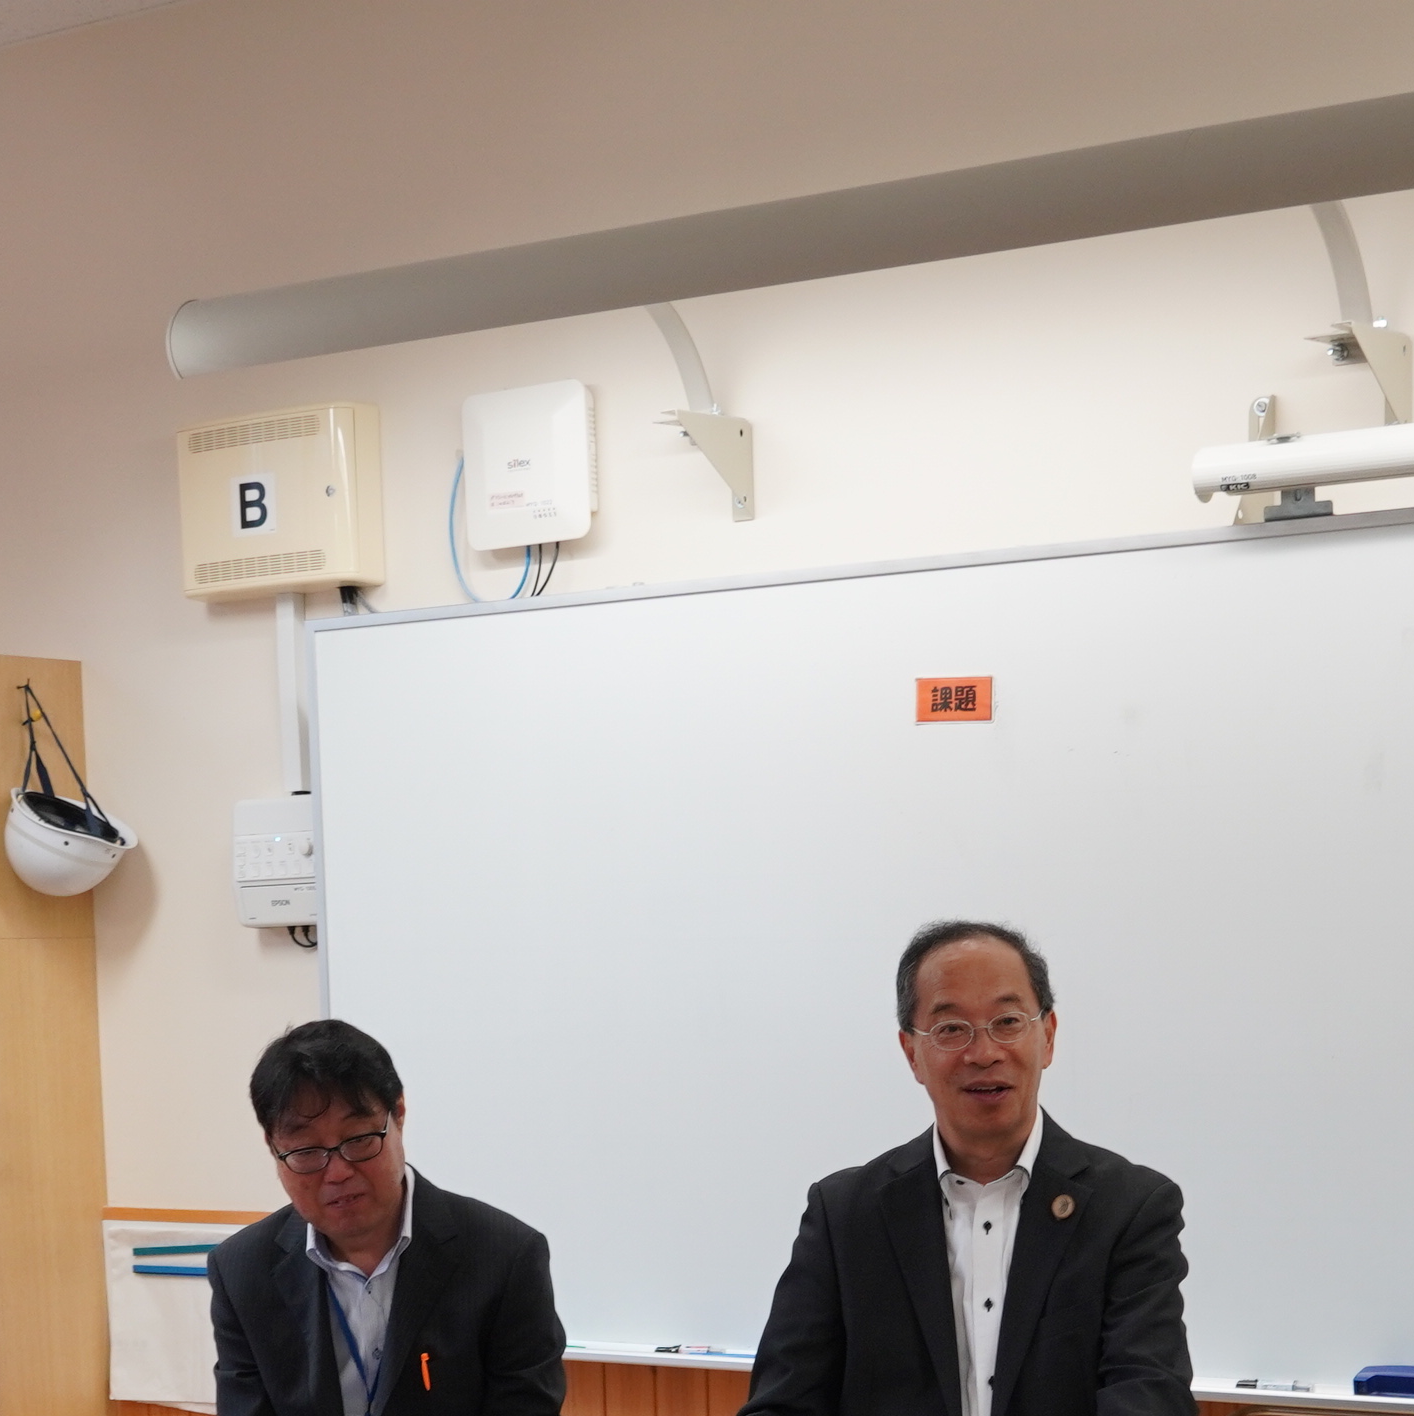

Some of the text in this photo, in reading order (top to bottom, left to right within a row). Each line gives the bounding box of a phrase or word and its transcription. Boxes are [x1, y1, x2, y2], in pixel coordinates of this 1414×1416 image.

[507, 459, 531, 470] silex
[239, 482, 267, 529] B
[930, 685, 976, 712] 課題
